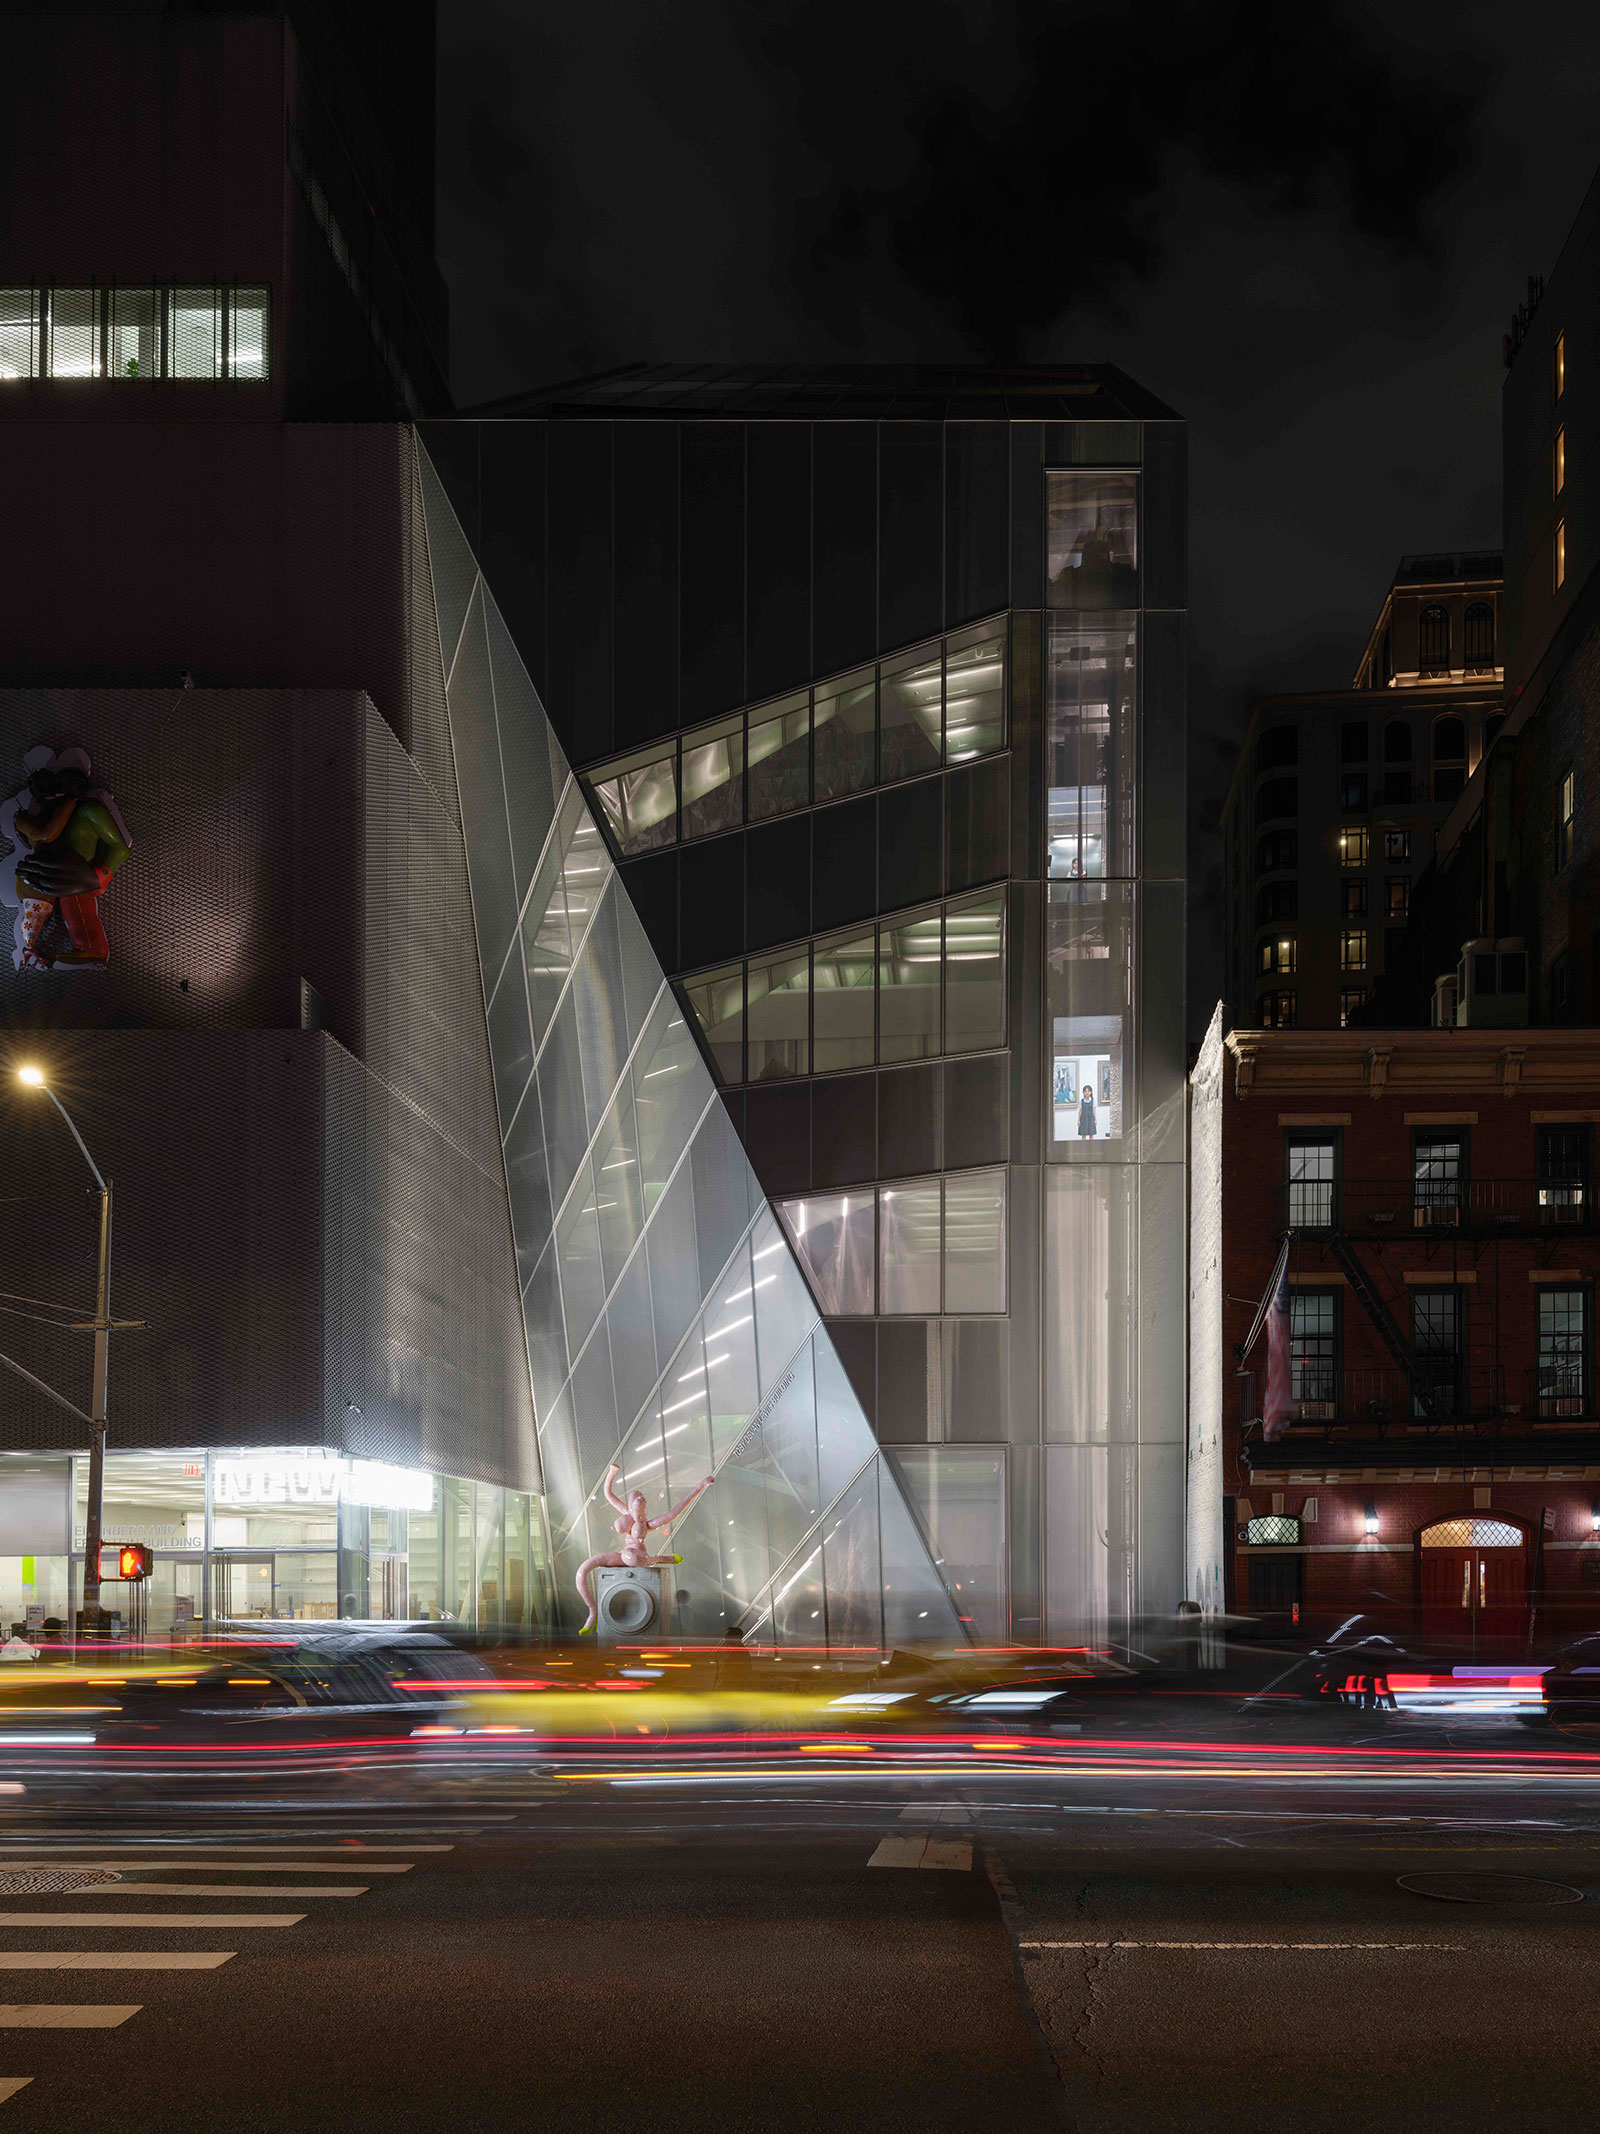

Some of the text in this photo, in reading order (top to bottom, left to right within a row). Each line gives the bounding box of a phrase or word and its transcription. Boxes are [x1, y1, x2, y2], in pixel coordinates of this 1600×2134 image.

[733, 1440, 747, 1458] TOBY
[743, 1419, 761, 1443] DEVAN
[771, 1371, 795, 1403] BUILDING
[74, 1523, 176, 1536] EINBERG AND
[142, 1536, 202, 1548] BUILDING
